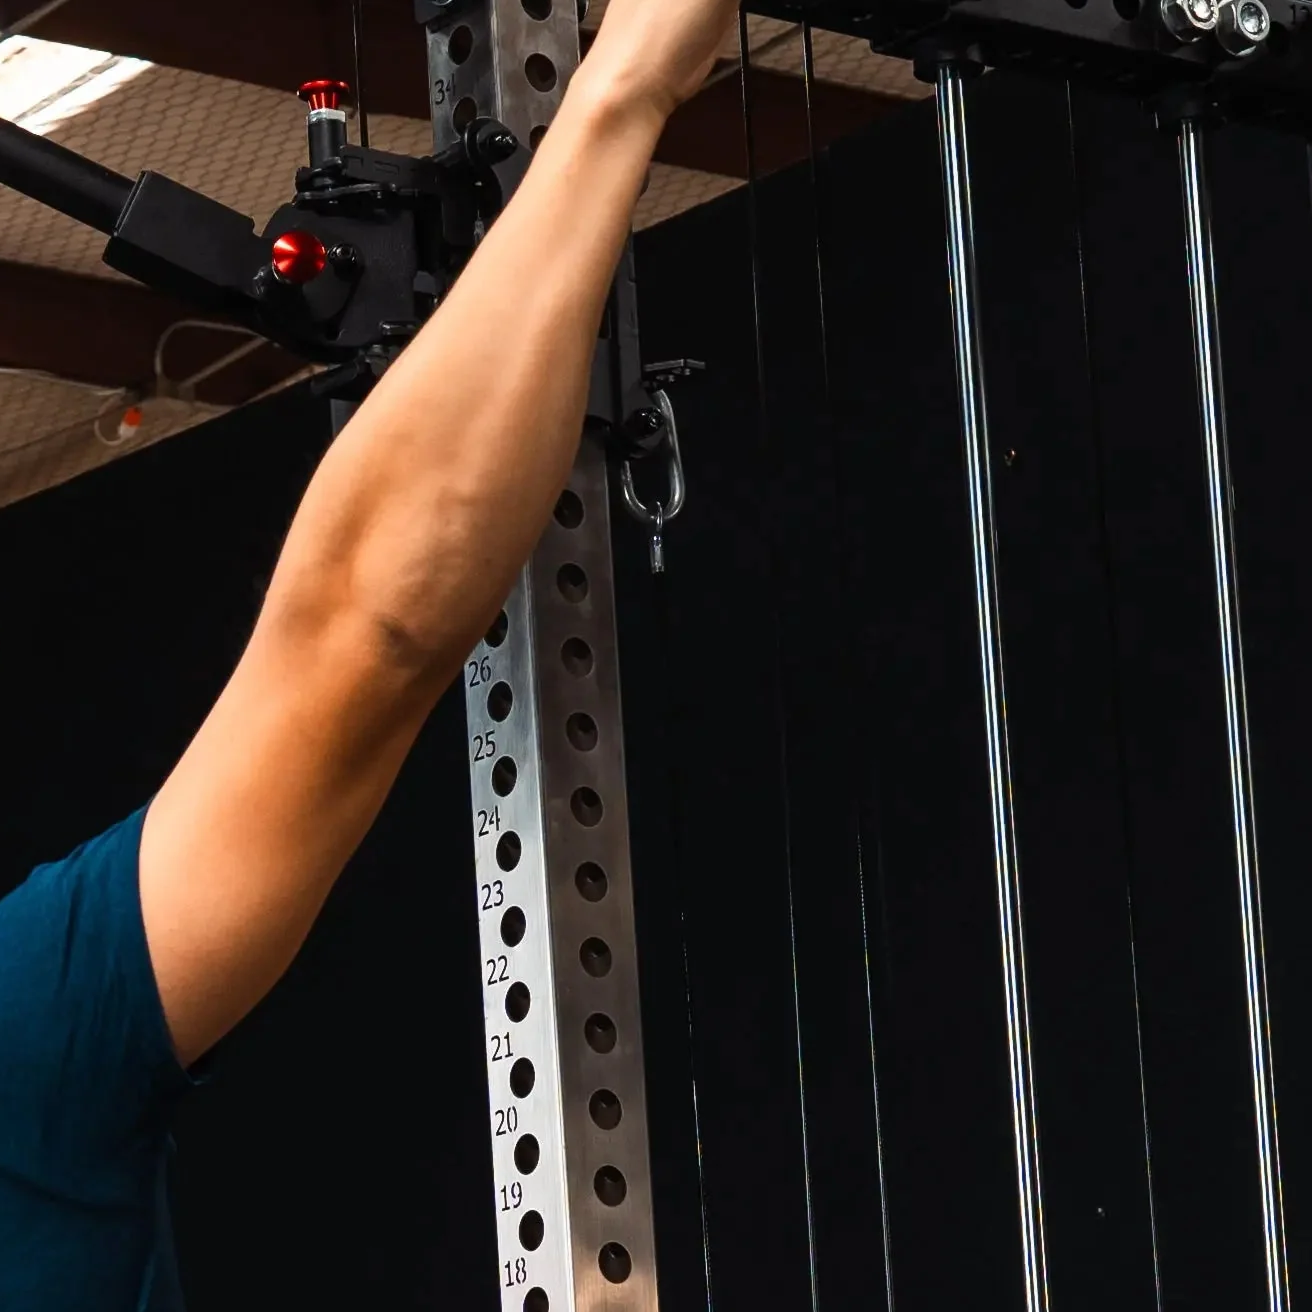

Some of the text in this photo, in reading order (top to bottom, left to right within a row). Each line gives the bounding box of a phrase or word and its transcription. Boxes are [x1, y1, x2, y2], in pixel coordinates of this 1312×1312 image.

[468, 656, 492, 687] 26
[473, 731, 496, 761] 25
[477, 805, 500, 837] 24
[481, 880, 504, 911] 23
[486, 955, 510, 986] 22
[491, 1031, 514, 1062] 21
[495, 1105, 518, 1136] 20
[500, 1181, 523, 1211] 19
[504, 1257, 527, 1287] 18
